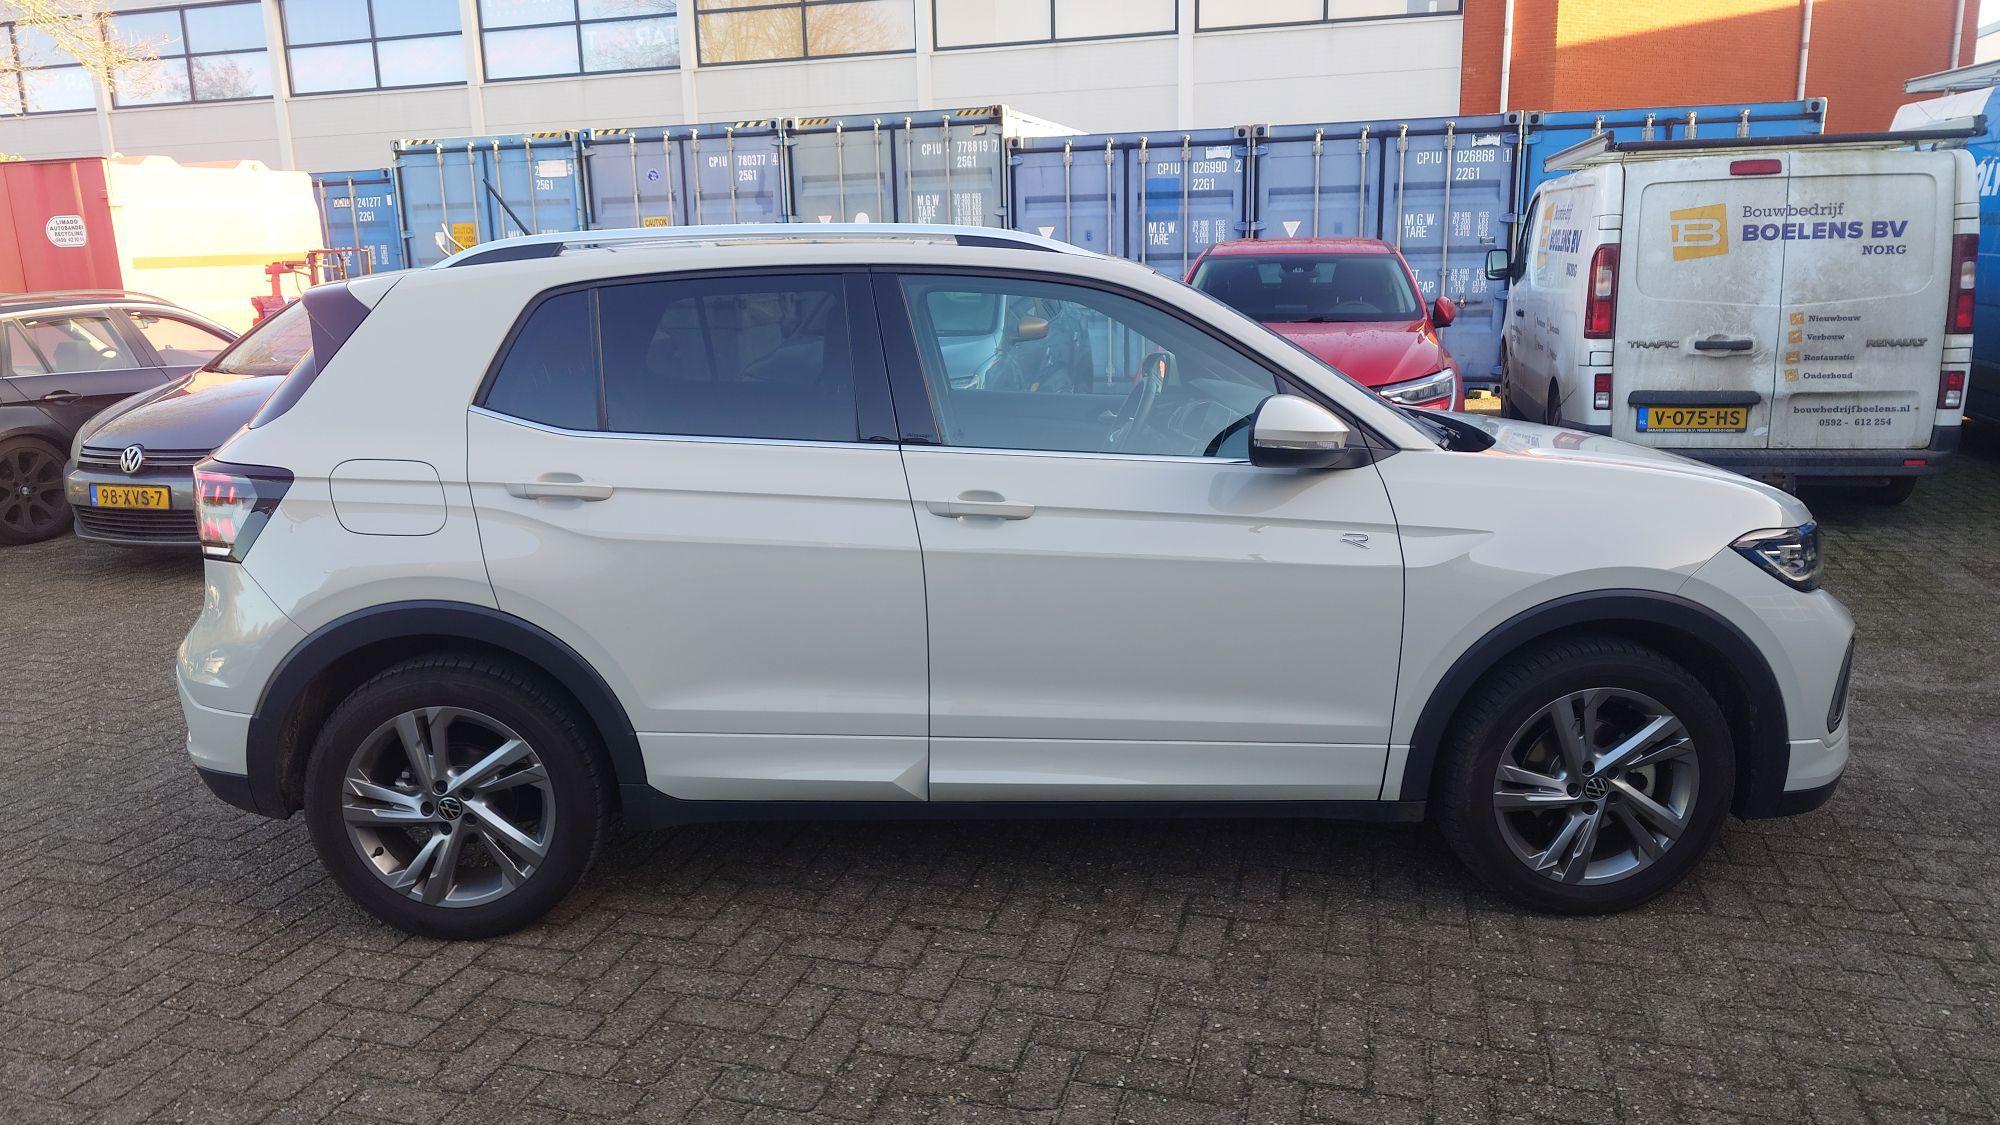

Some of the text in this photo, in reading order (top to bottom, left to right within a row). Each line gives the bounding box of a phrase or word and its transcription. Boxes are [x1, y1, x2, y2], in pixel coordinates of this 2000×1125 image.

[921, 142, 942, 155] CPIU
[957, 140, 988, 153] 778819
[709, 155, 728, 167] CPIU
[737, 154, 766, 166] 780377
[957, 156, 977, 168] 25G1
[1417, 151, 1442, 165] CPIU
[1457, 149, 1495, 163] 026868
[1157, 162, 1180, 175] CPIU
[1193, 160, 1227, 174] 026990
[1456, 167, 1480, 180] 22G1
[738, 170, 757, 181] 25G1
[536, 179, 554, 190] 25G1
[1192, 178, 1215, 190] 22G1
[357, 196, 381, 208] 241277
[359, 210, 375, 222] 22G1
[918, 205, 936, 217] TARE
[1742, 202, 1845, 219] Bouwbedrijf
[1405, 225, 1428, 238] TARE
[1742, 220, 1909, 242] BOELENS BV
[1149, 233, 1169, 245] TARE
[1861, 244, 1907, 256] NORG
[1808, 314, 1862, 323] Nieuwbouw
[1806, 333, 1846, 342] Verbouw
[1865, 338, 1928, 349] RENAULT
[1627, 340, 1680, 349] TRAFIC
[1803, 353, 1856, 362] Restauratie
[1803, 371, 1854, 380] Onderhoud
[1654, 410, 1741, 426] V-075-HS
[1819, 419, 1842, 427] 0592
[1854, 418, 1872, 426] 612
[1874, 418, 1892, 426] 254
[101, 488, 162, 506] 98-XVS-7
